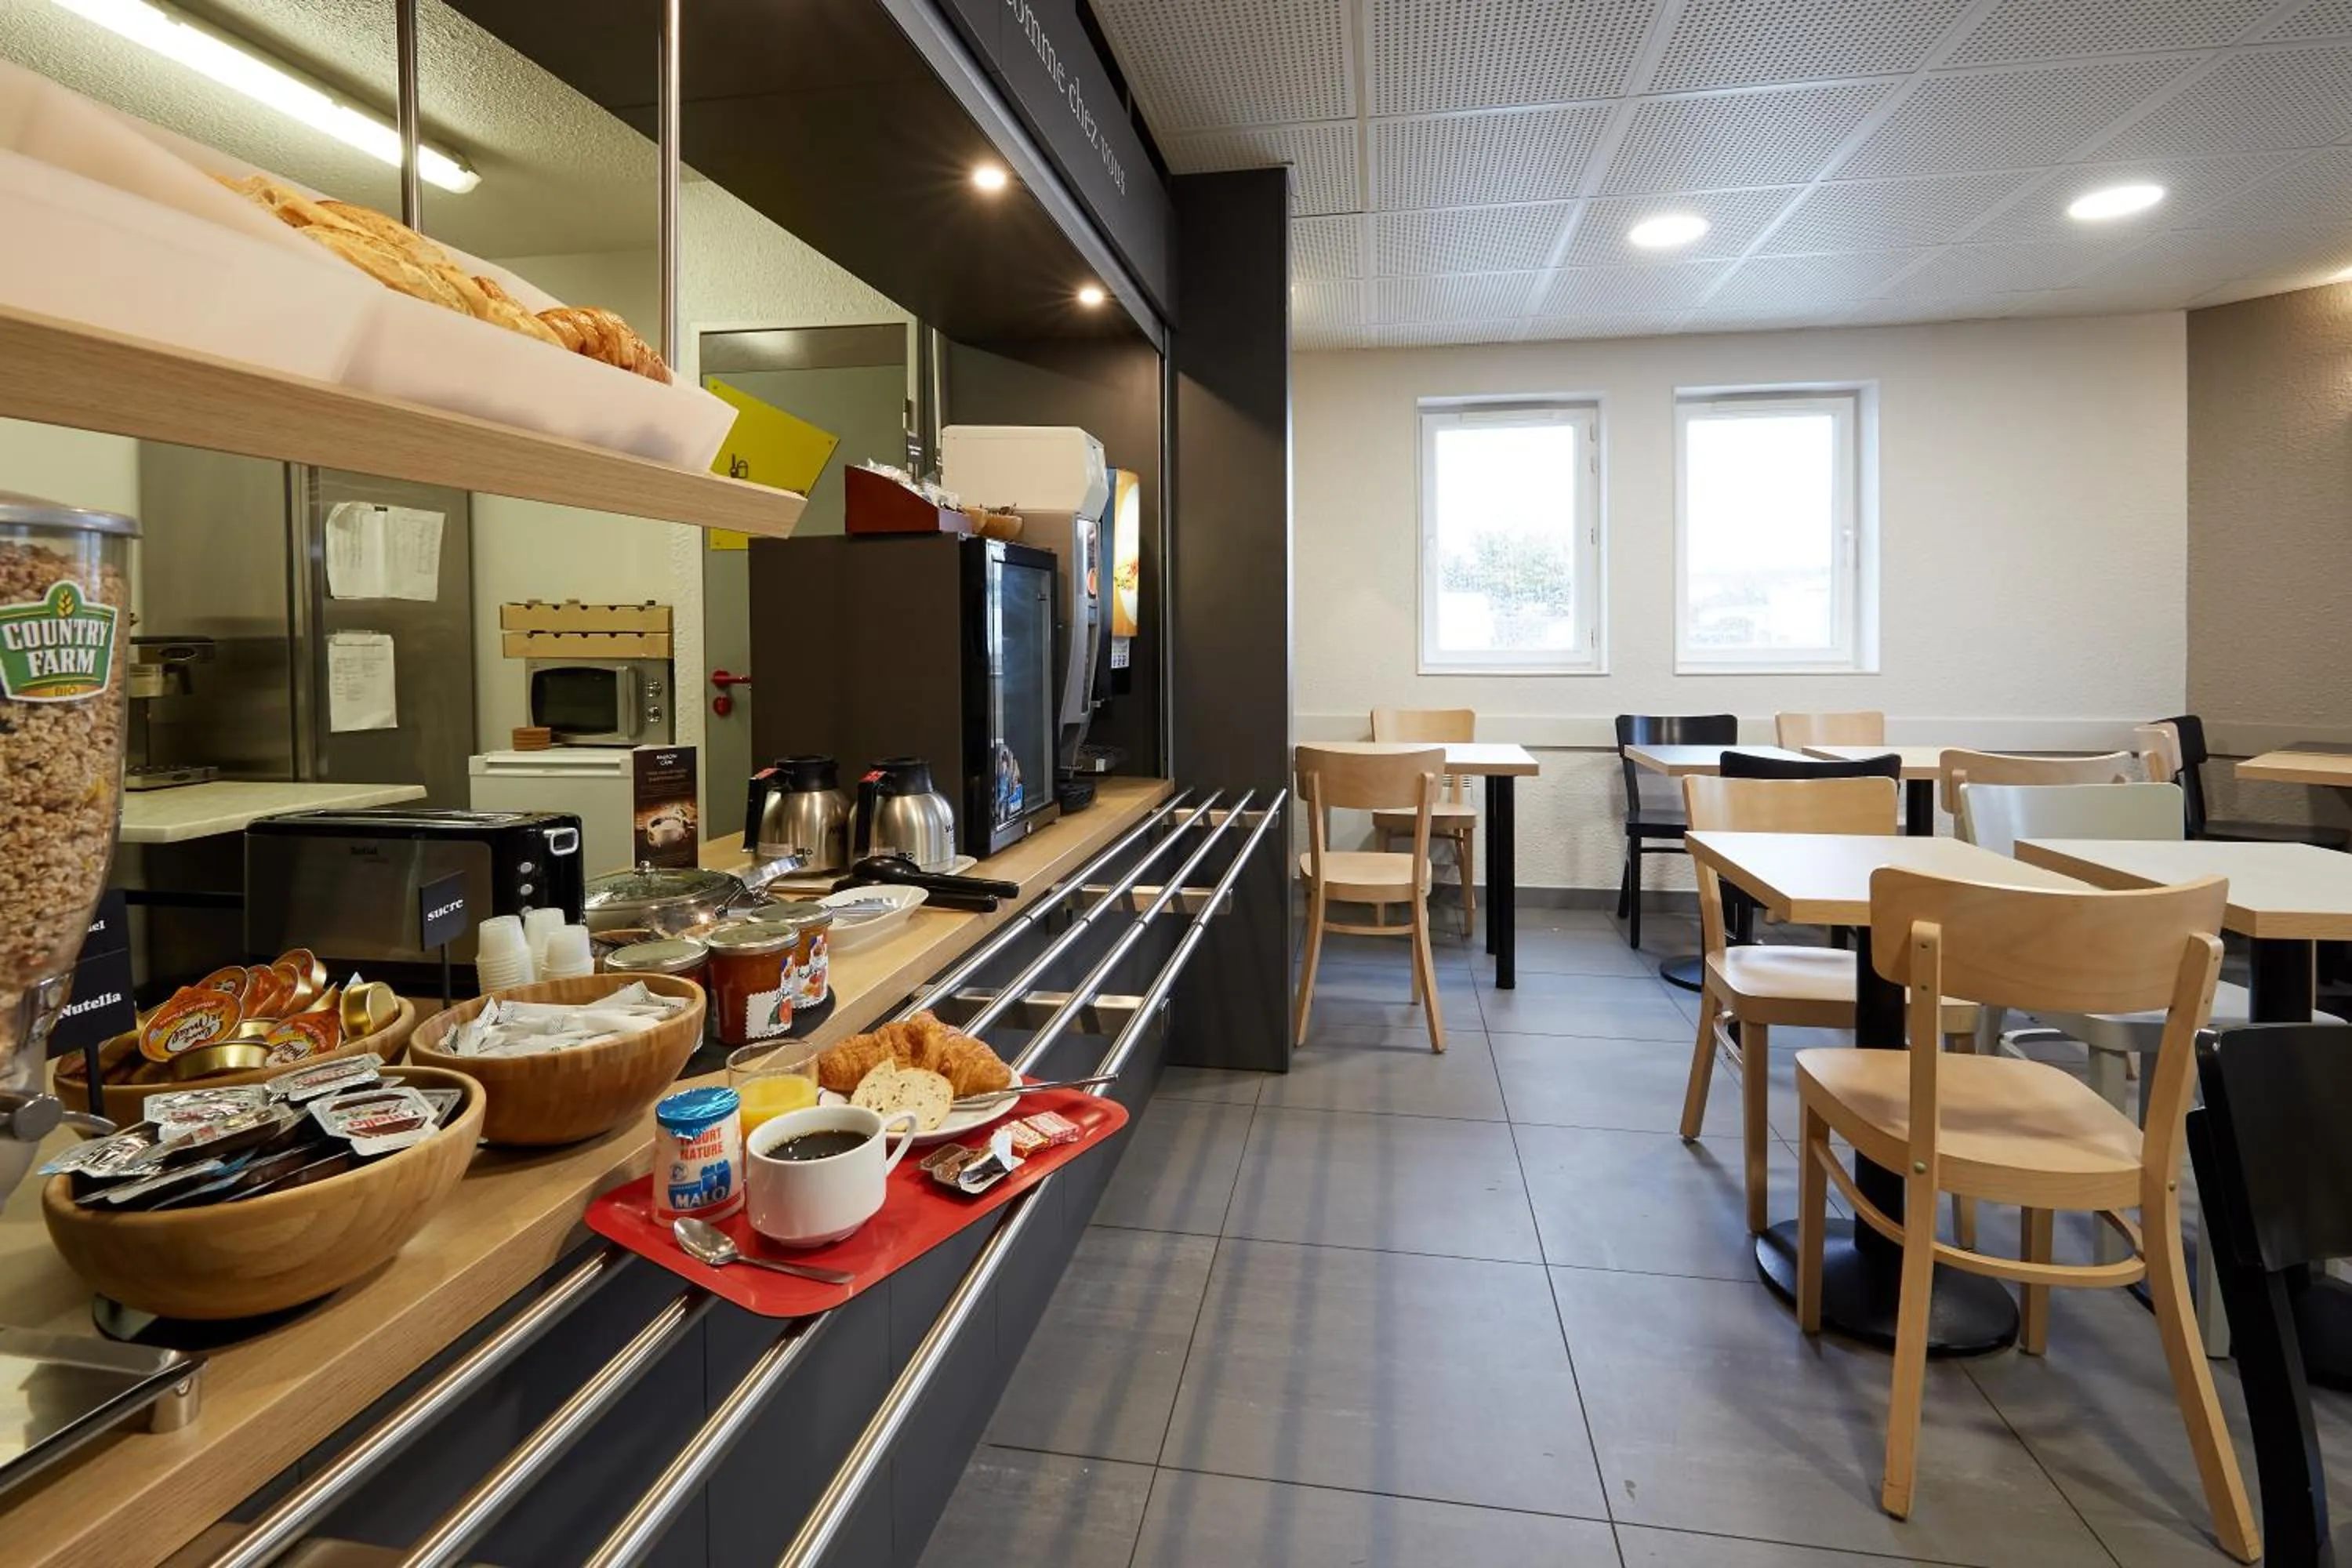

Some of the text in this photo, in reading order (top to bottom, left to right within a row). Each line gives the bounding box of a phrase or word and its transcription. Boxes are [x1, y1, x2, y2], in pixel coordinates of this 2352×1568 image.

[1069, 76, 1098, 150] chez
[1099, 134, 1126, 196] vous
[2, 618, 110, 651] COUNTRY
[27, 648, 96, 677] FARM
[427, 899, 464, 921] sucre
[58, 991, 122, 1019] Nutella
[680, 1142, 724, 1160] NATURE
[676, 1186, 728, 1208] MALO
